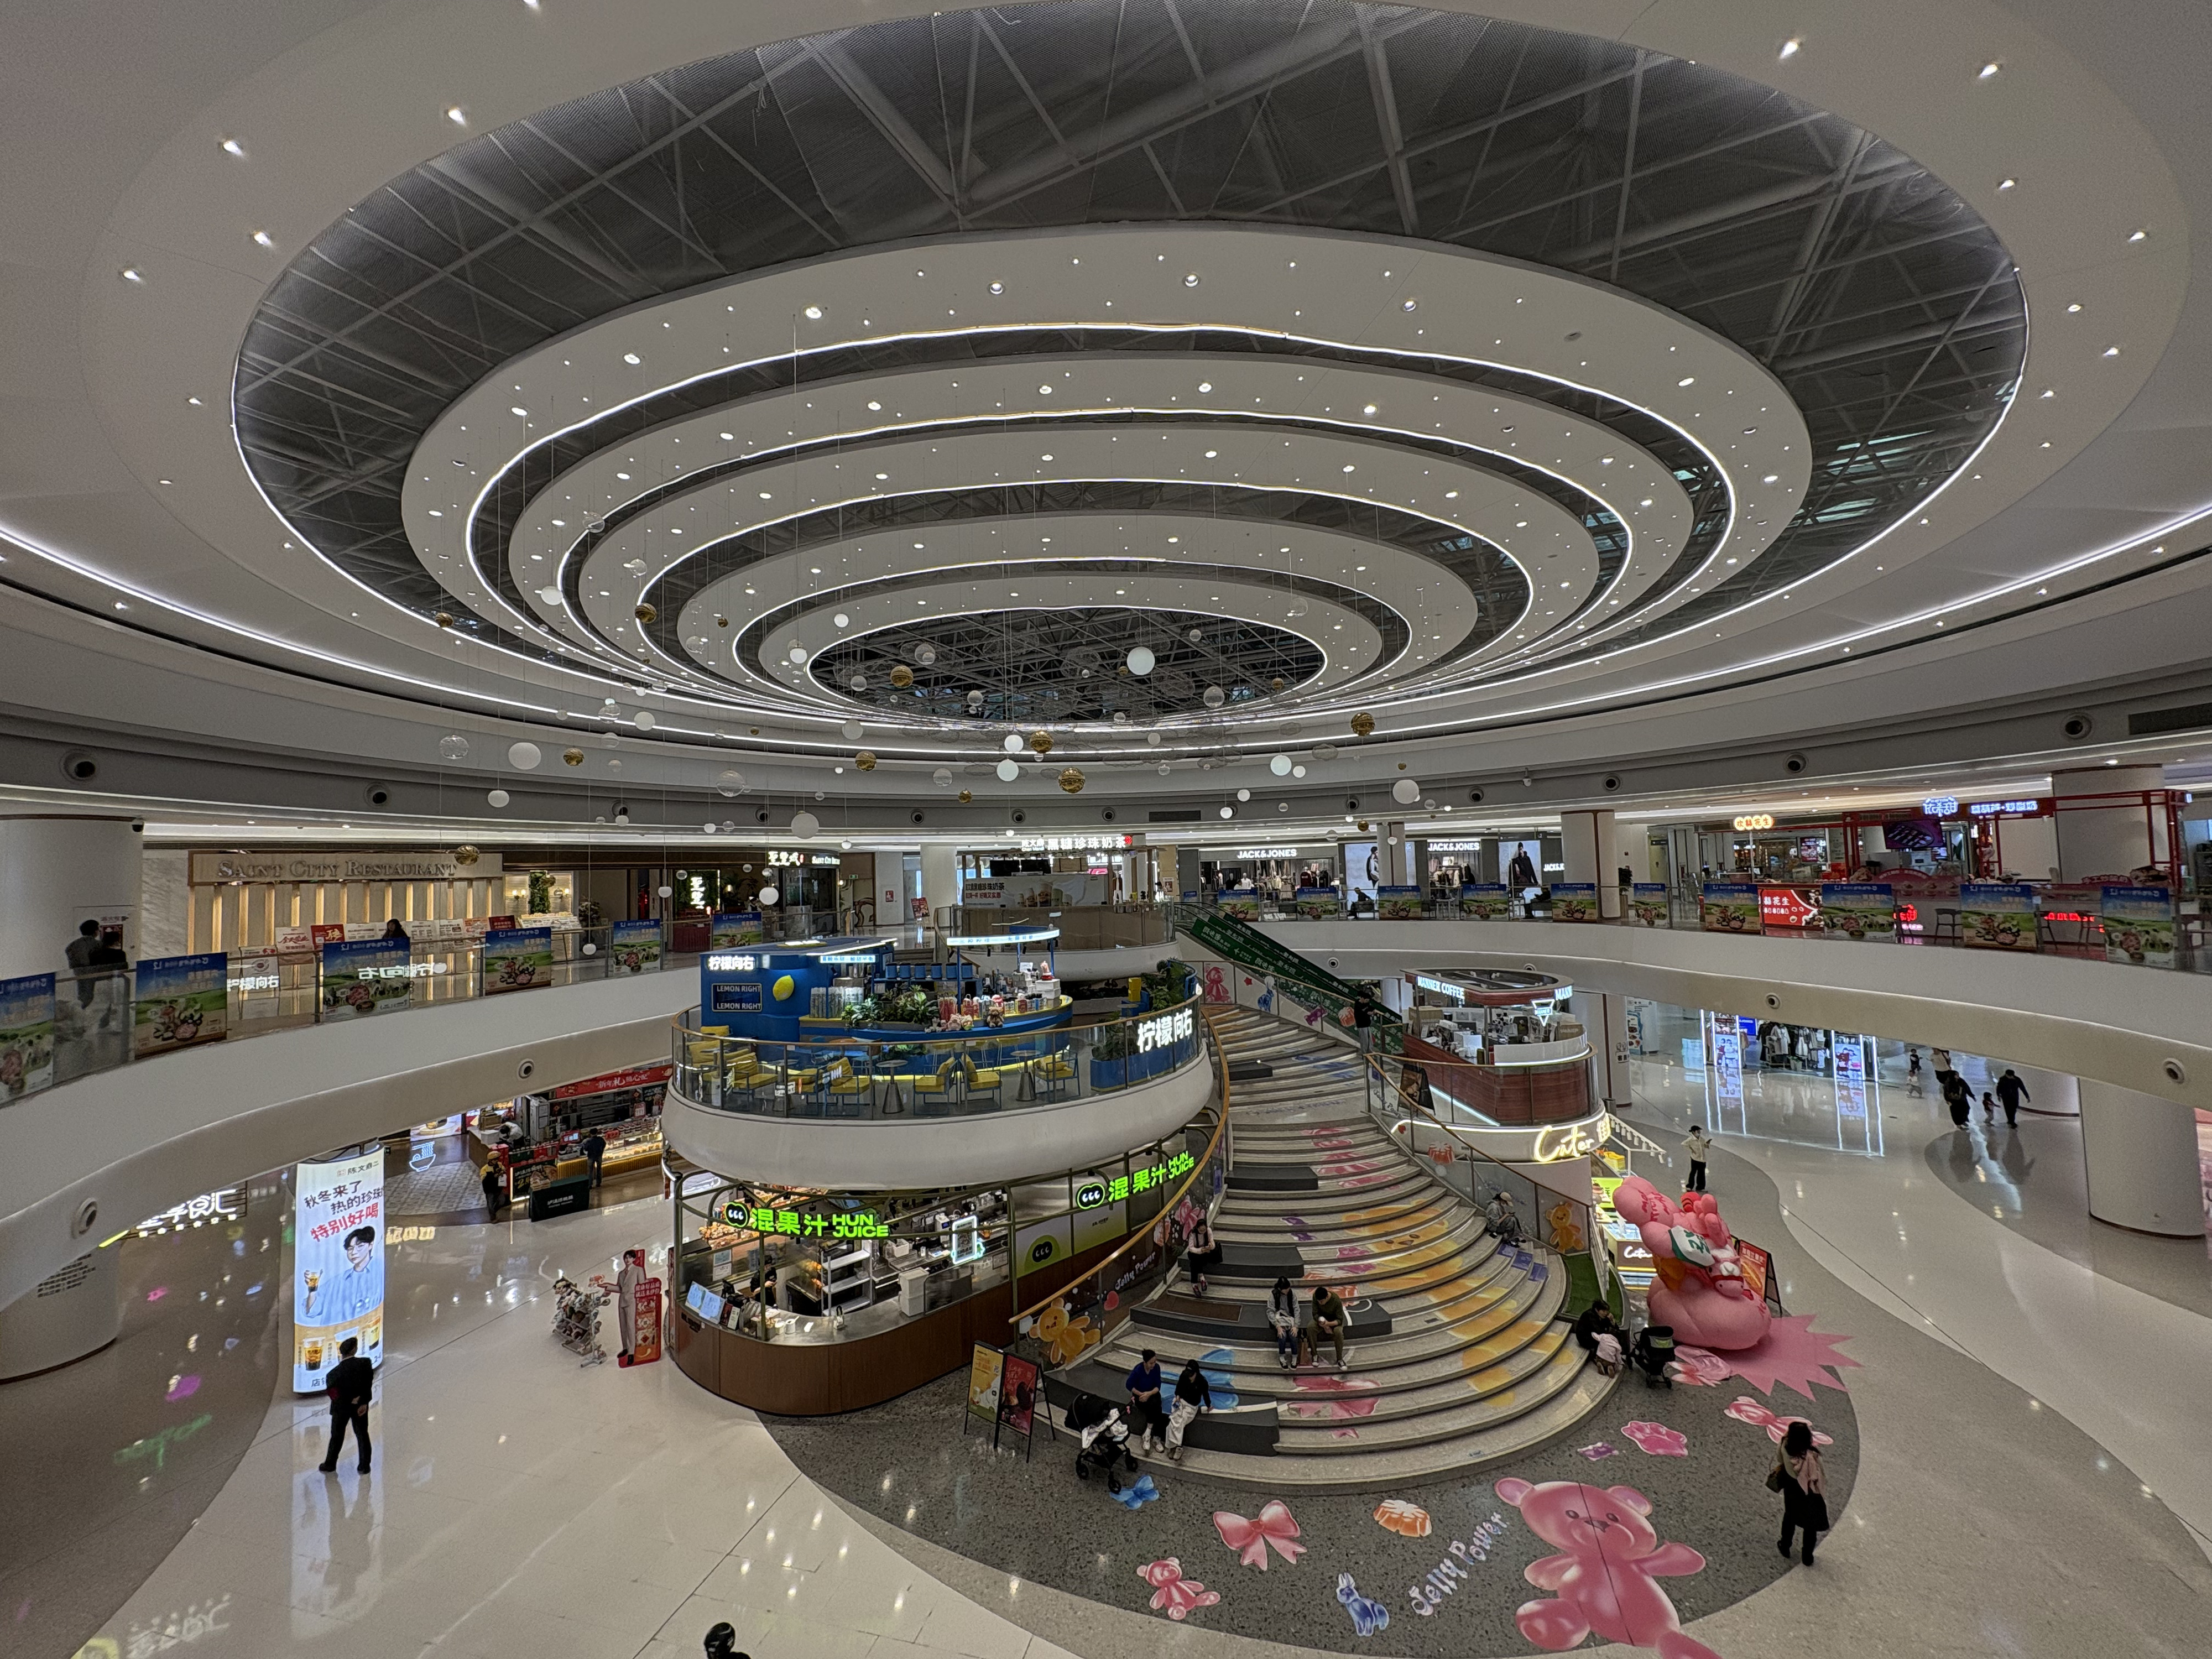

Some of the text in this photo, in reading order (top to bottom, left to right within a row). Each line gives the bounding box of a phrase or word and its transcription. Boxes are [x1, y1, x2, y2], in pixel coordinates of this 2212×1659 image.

[1047, 837, 1126, 851] 黑糖珍珠奶茶
[1237, 848, 1297, 859] JACK&JONES
[1428, 842, 1480, 852] JACK&JONES
[708, 956, 754, 970] 柠檬向右
[1441, 983, 1465, 999] COFFEE
[1138, 1008, 1192, 1053] 柠檬向右
[1168, 1151, 1188, 1169] HUN
[1168, 1157, 1194, 1179] JUICE
[1108, 1164, 1167, 1202] 混果汁
[304, 1180, 362, 1209] 秋冬来了
[331, 1187, 384, 1215] 热的珍珠
[310, 1202, 379, 1242] 特别好喝
[751, 1207, 828, 1237] 混果汁
[832, 1214, 873, 1225] HUN
[832, 1225, 889, 1237] JUICE
[1115, 1251, 1156, 1290] Jelly Power
[1408, 1512, 1508, 1616] Jelly Power
